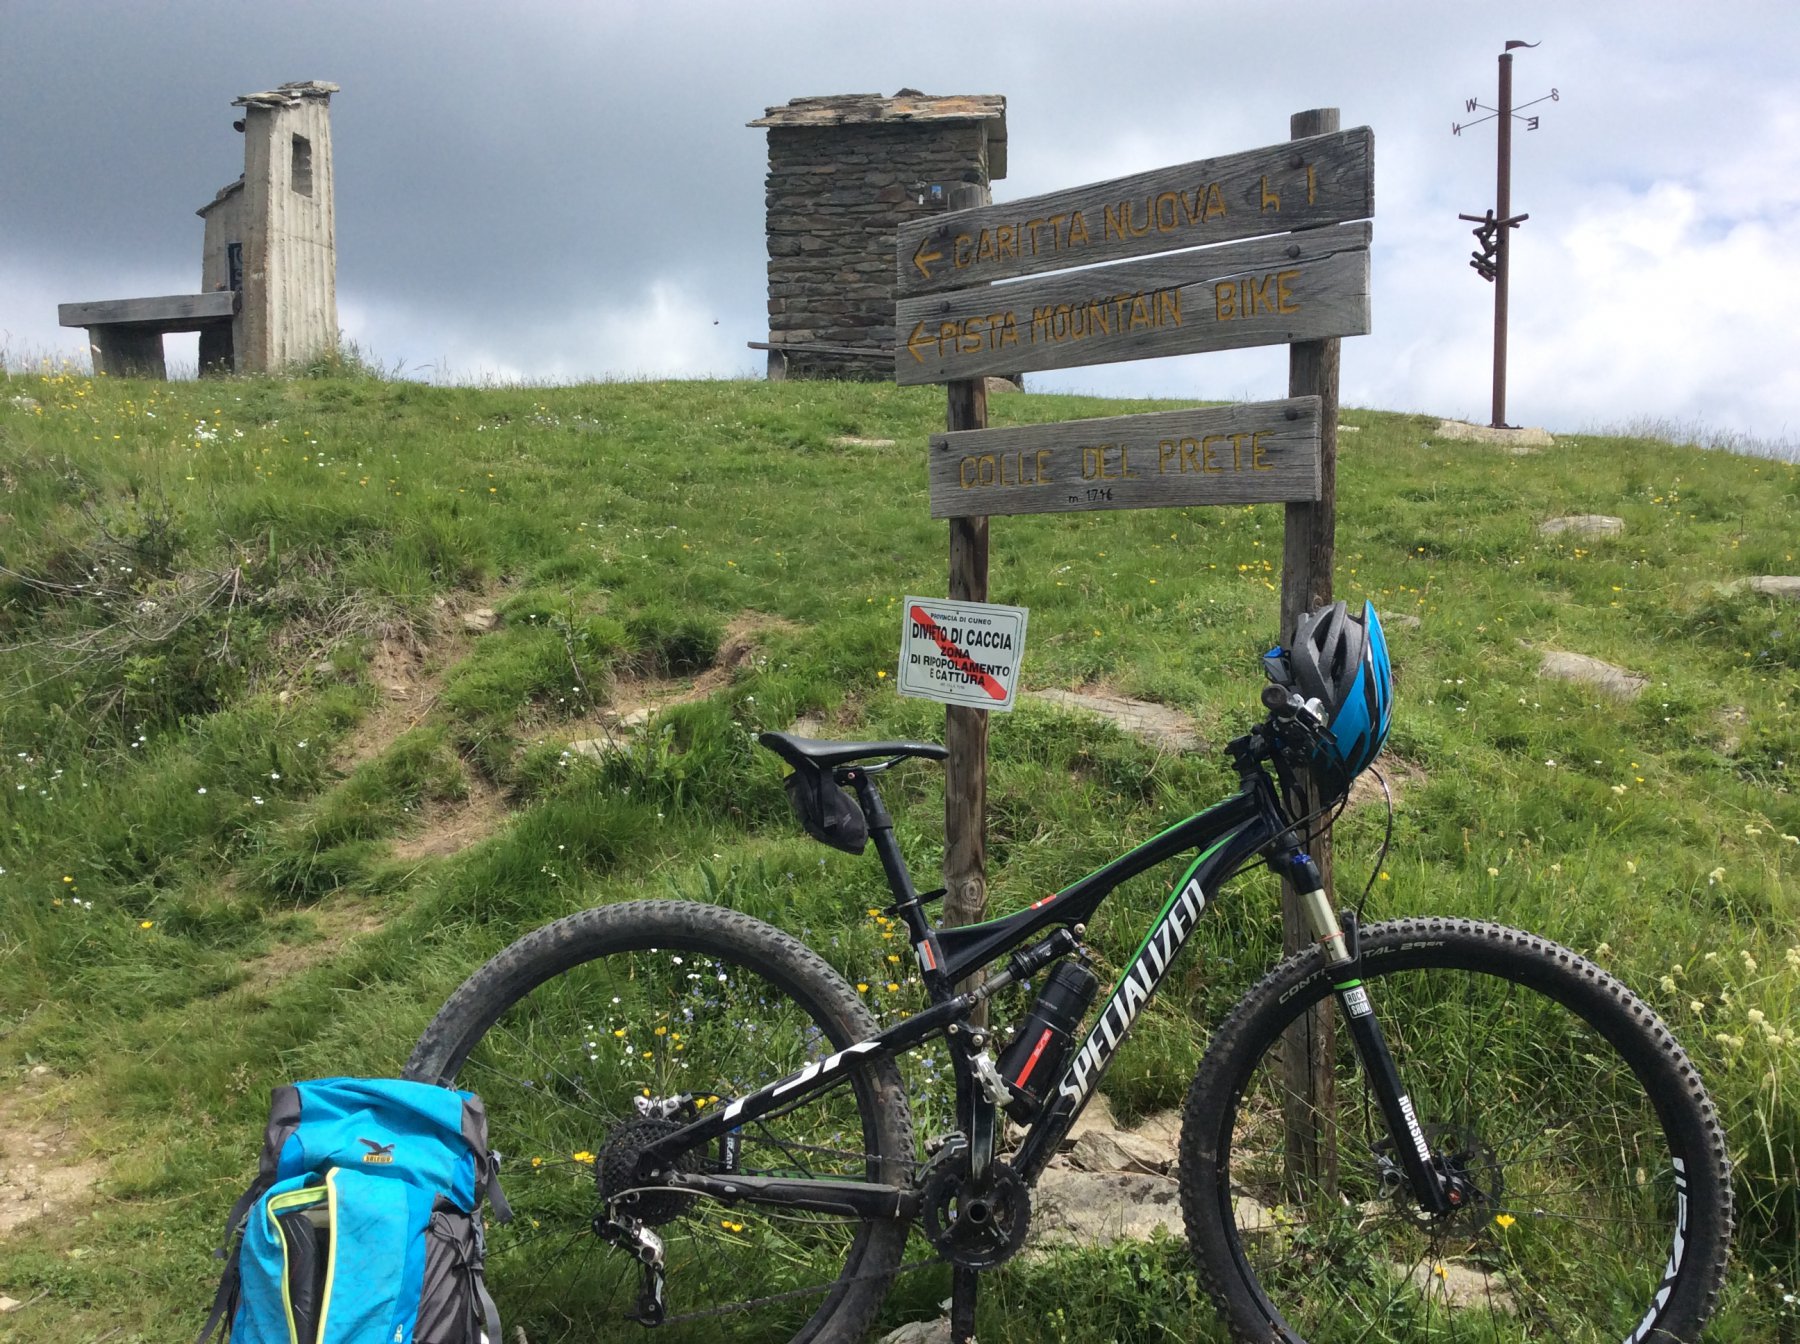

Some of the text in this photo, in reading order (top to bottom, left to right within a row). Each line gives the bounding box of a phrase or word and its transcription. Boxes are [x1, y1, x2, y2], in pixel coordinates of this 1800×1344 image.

[1466, 97, 1477, 113] W
[1103, 181, 1227, 241] NUOVA
[938, 270, 1301, 357] PISTA MOUNTAIN BIKE
[959, 431, 1277, 489] COLLE DEL PRETE
[967, 617, 992, 626] CUNEO
[912, 622, 1012, 650] DIVIETO DI CACCIA
[910, 653, 1010, 677] DI RIPOPOLAMENTO
[940, 646, 970, 659] ZONA
[929, 668, 934, 678] E
[935, 669, 986, 687] CATTURA
[1058, 878, 1206, 1118] SPECIALIZED
